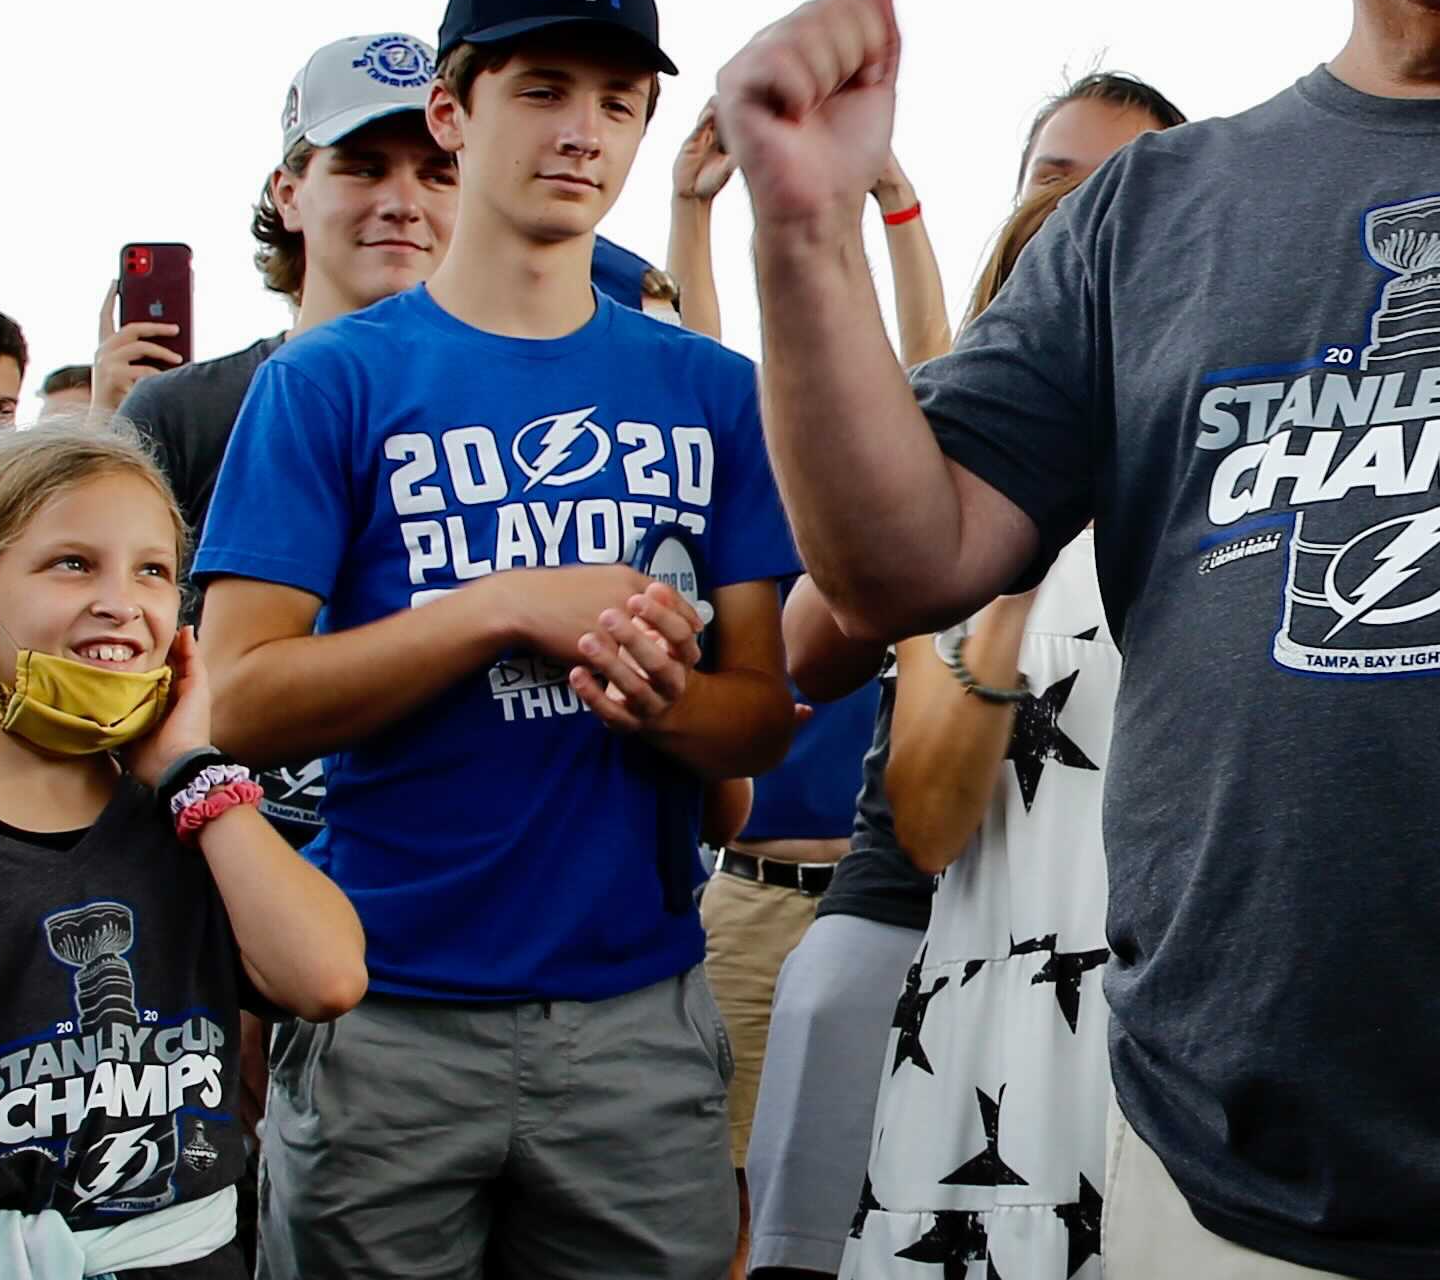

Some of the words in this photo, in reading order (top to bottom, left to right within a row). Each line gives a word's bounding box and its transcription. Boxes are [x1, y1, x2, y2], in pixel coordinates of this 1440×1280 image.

[1324, 347, 1353, 365] 20
[383, 426, 509, 515] 20
[616, 421, 714, 507] 20
[1305, 653, 1359, 669] TAMPA
[1364, 654, 1396, 669] BAY
[144, 1010, 159, 1022] 20
[56, 1021, 73, 1034] 20
[154, 1017, 225, 1063] CUP
